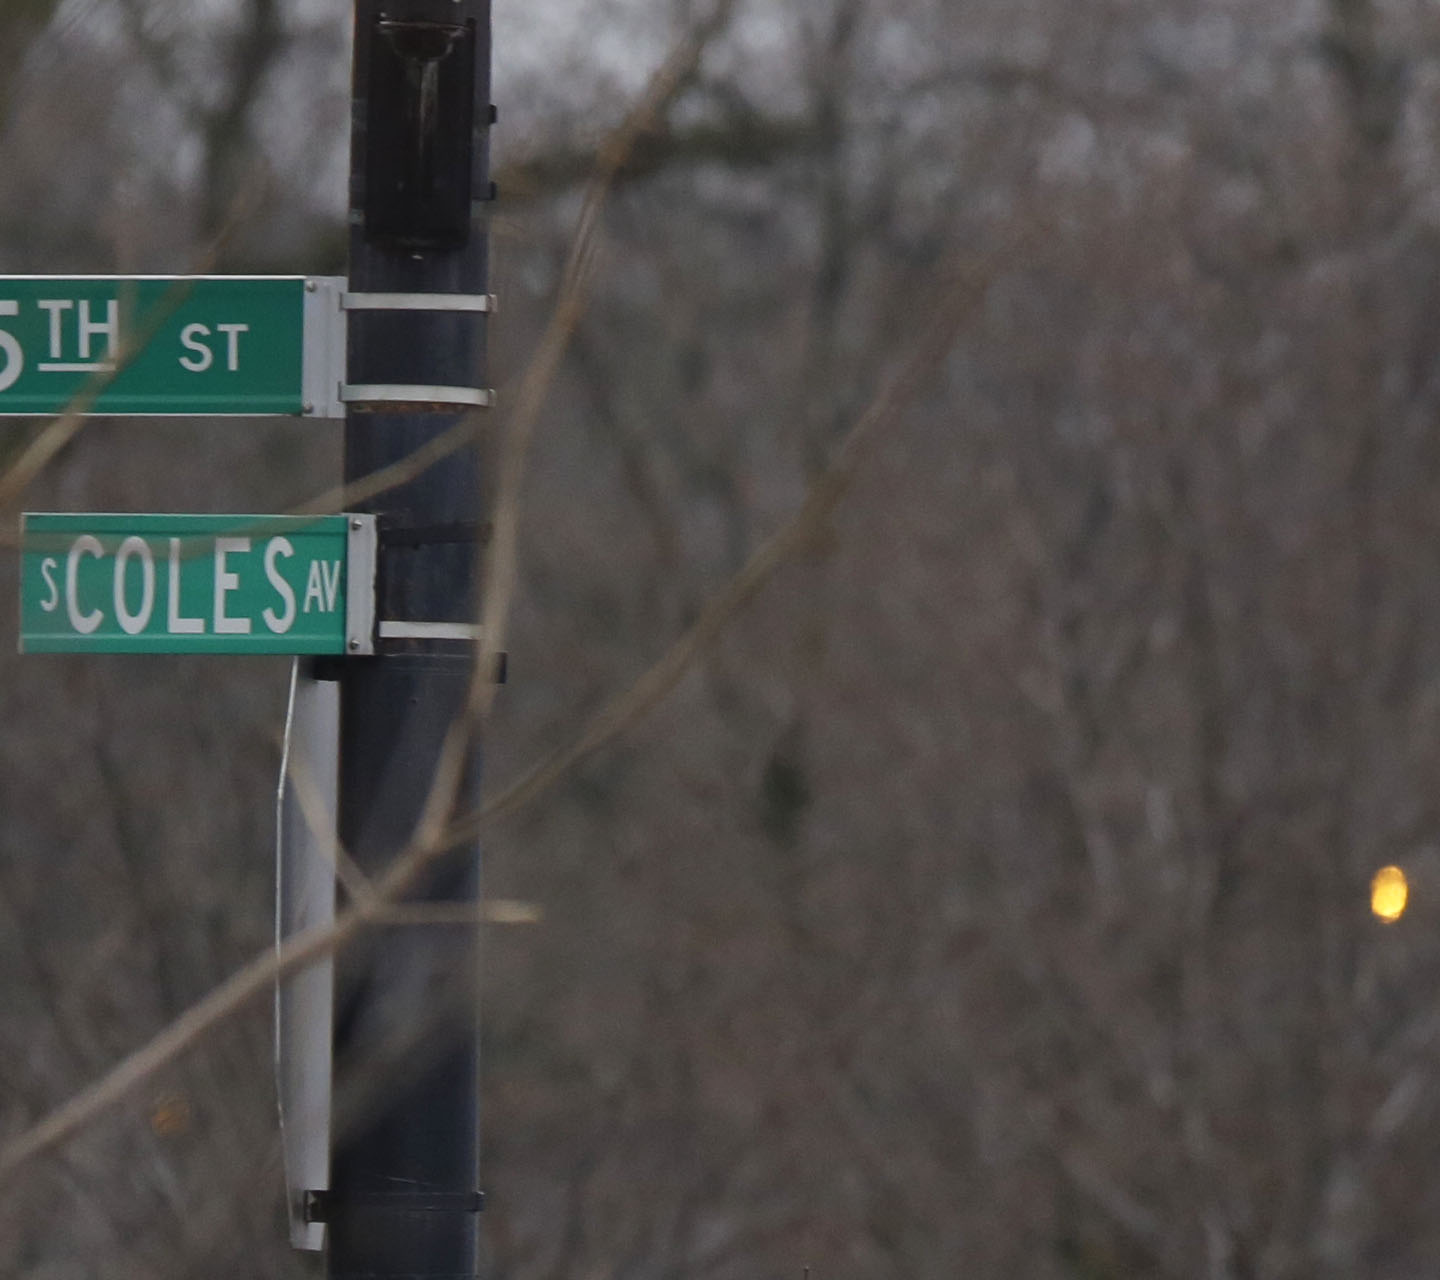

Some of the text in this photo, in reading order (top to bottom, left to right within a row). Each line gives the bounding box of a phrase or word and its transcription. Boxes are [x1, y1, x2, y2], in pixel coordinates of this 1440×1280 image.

[179, 322, 249, 372] ST
[40, 534, 342, 636] S COLES AV
